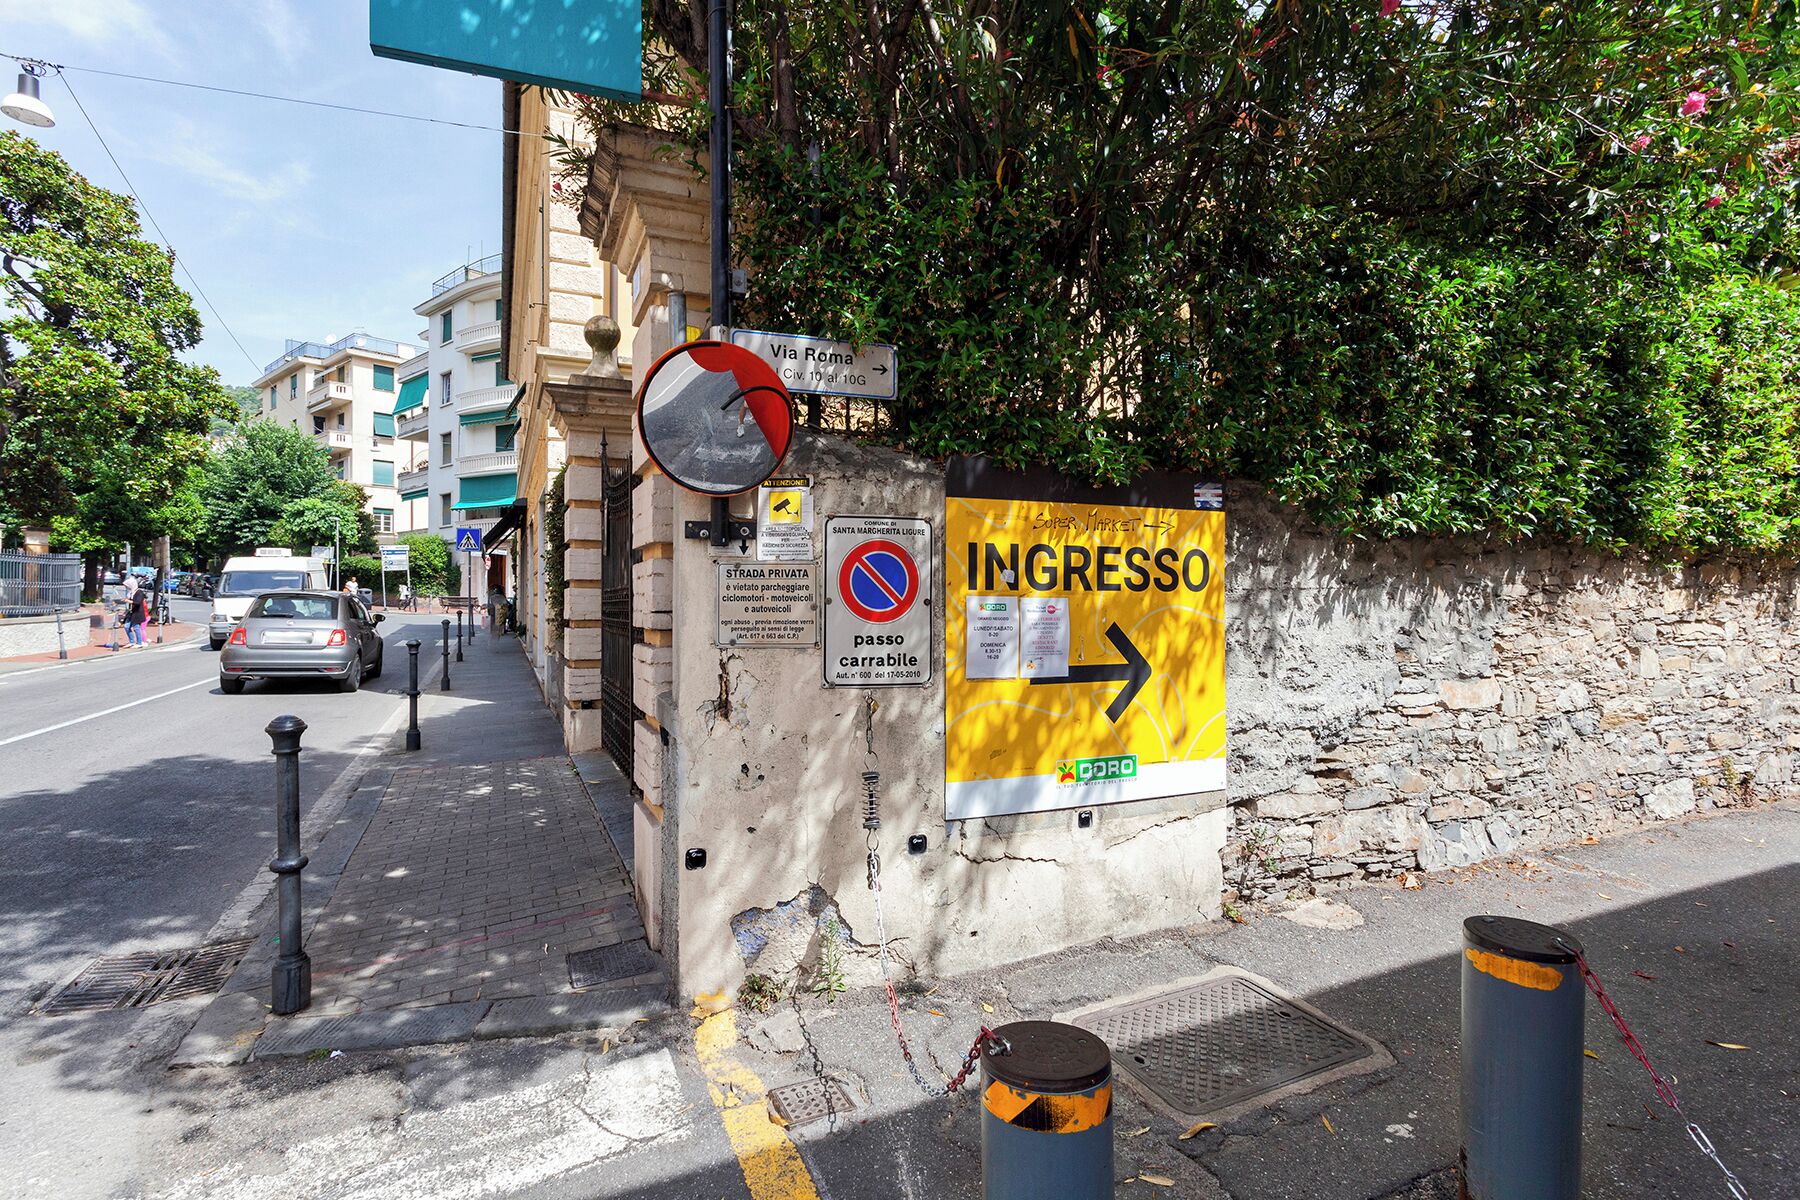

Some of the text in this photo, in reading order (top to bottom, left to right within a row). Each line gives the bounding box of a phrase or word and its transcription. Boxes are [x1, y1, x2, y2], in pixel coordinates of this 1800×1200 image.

[770, 343, 854, 366] Via Roma
[783, 367, 805, 381] Civ.
[810, 371, 822, 382] 10
[827, 372, 838, 383] al
[843, 374, 866, 386] 10G
[726, 569, 809, 578] STRADA PRIVATA
[967, 542, 1210, 592] INGRESSO
[726, 583, 810, 593] è vietato parcheggiare
[722, 594, 765, 602] ciclomotori
[771, 594, 814, 602] motoveicoli
[751, 604, 792, 613] autoveicoli
[854, 635, 904, 648] passo
[840, 653, 918, 667] carrabile
[1080, 760, 1133, 779] DORO
[795, 1087, 822, 1099] GAS
